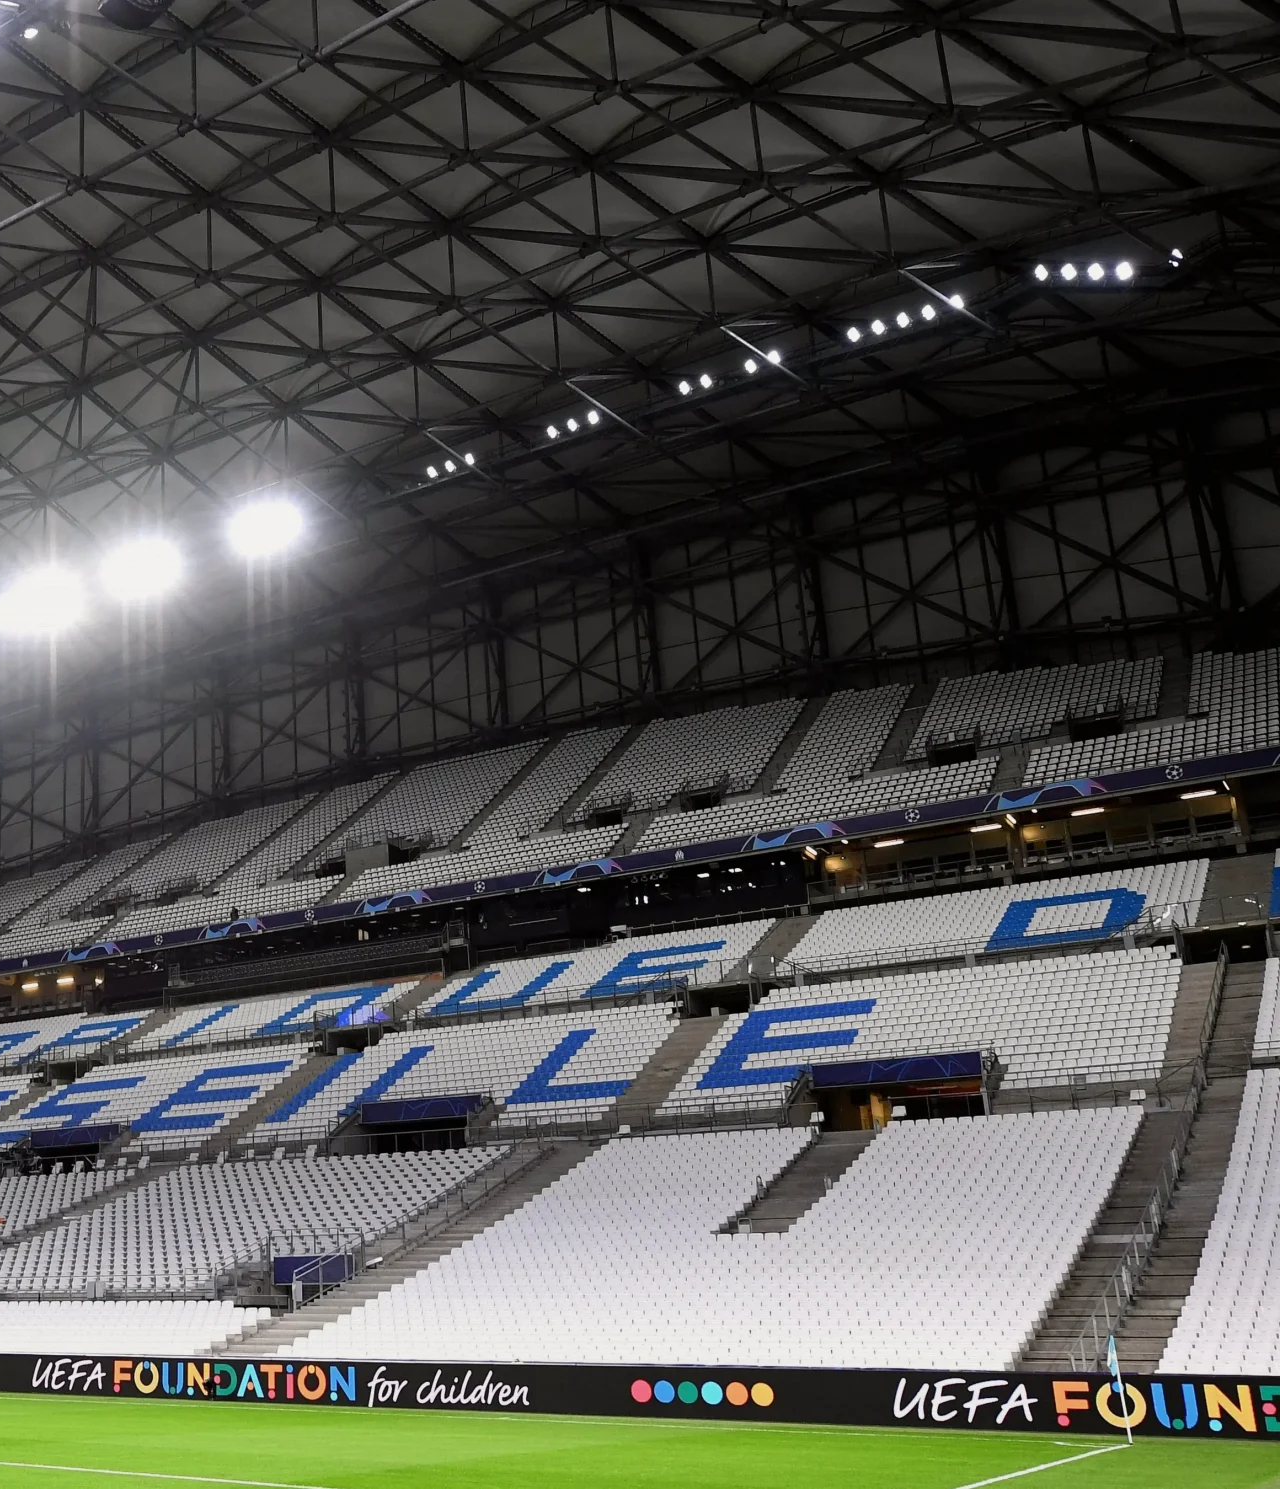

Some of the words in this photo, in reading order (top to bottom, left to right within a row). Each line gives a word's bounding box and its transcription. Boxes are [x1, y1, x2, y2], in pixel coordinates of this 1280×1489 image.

[31, 1357, 106, 1391] UEFA
[113, 1360, 356, 1401] FOUNDATION
[367, 1365, 408, 1408] for
[416, 1368, 530, 1406] children
[892, 1377, 1038, 1425] UEFA
